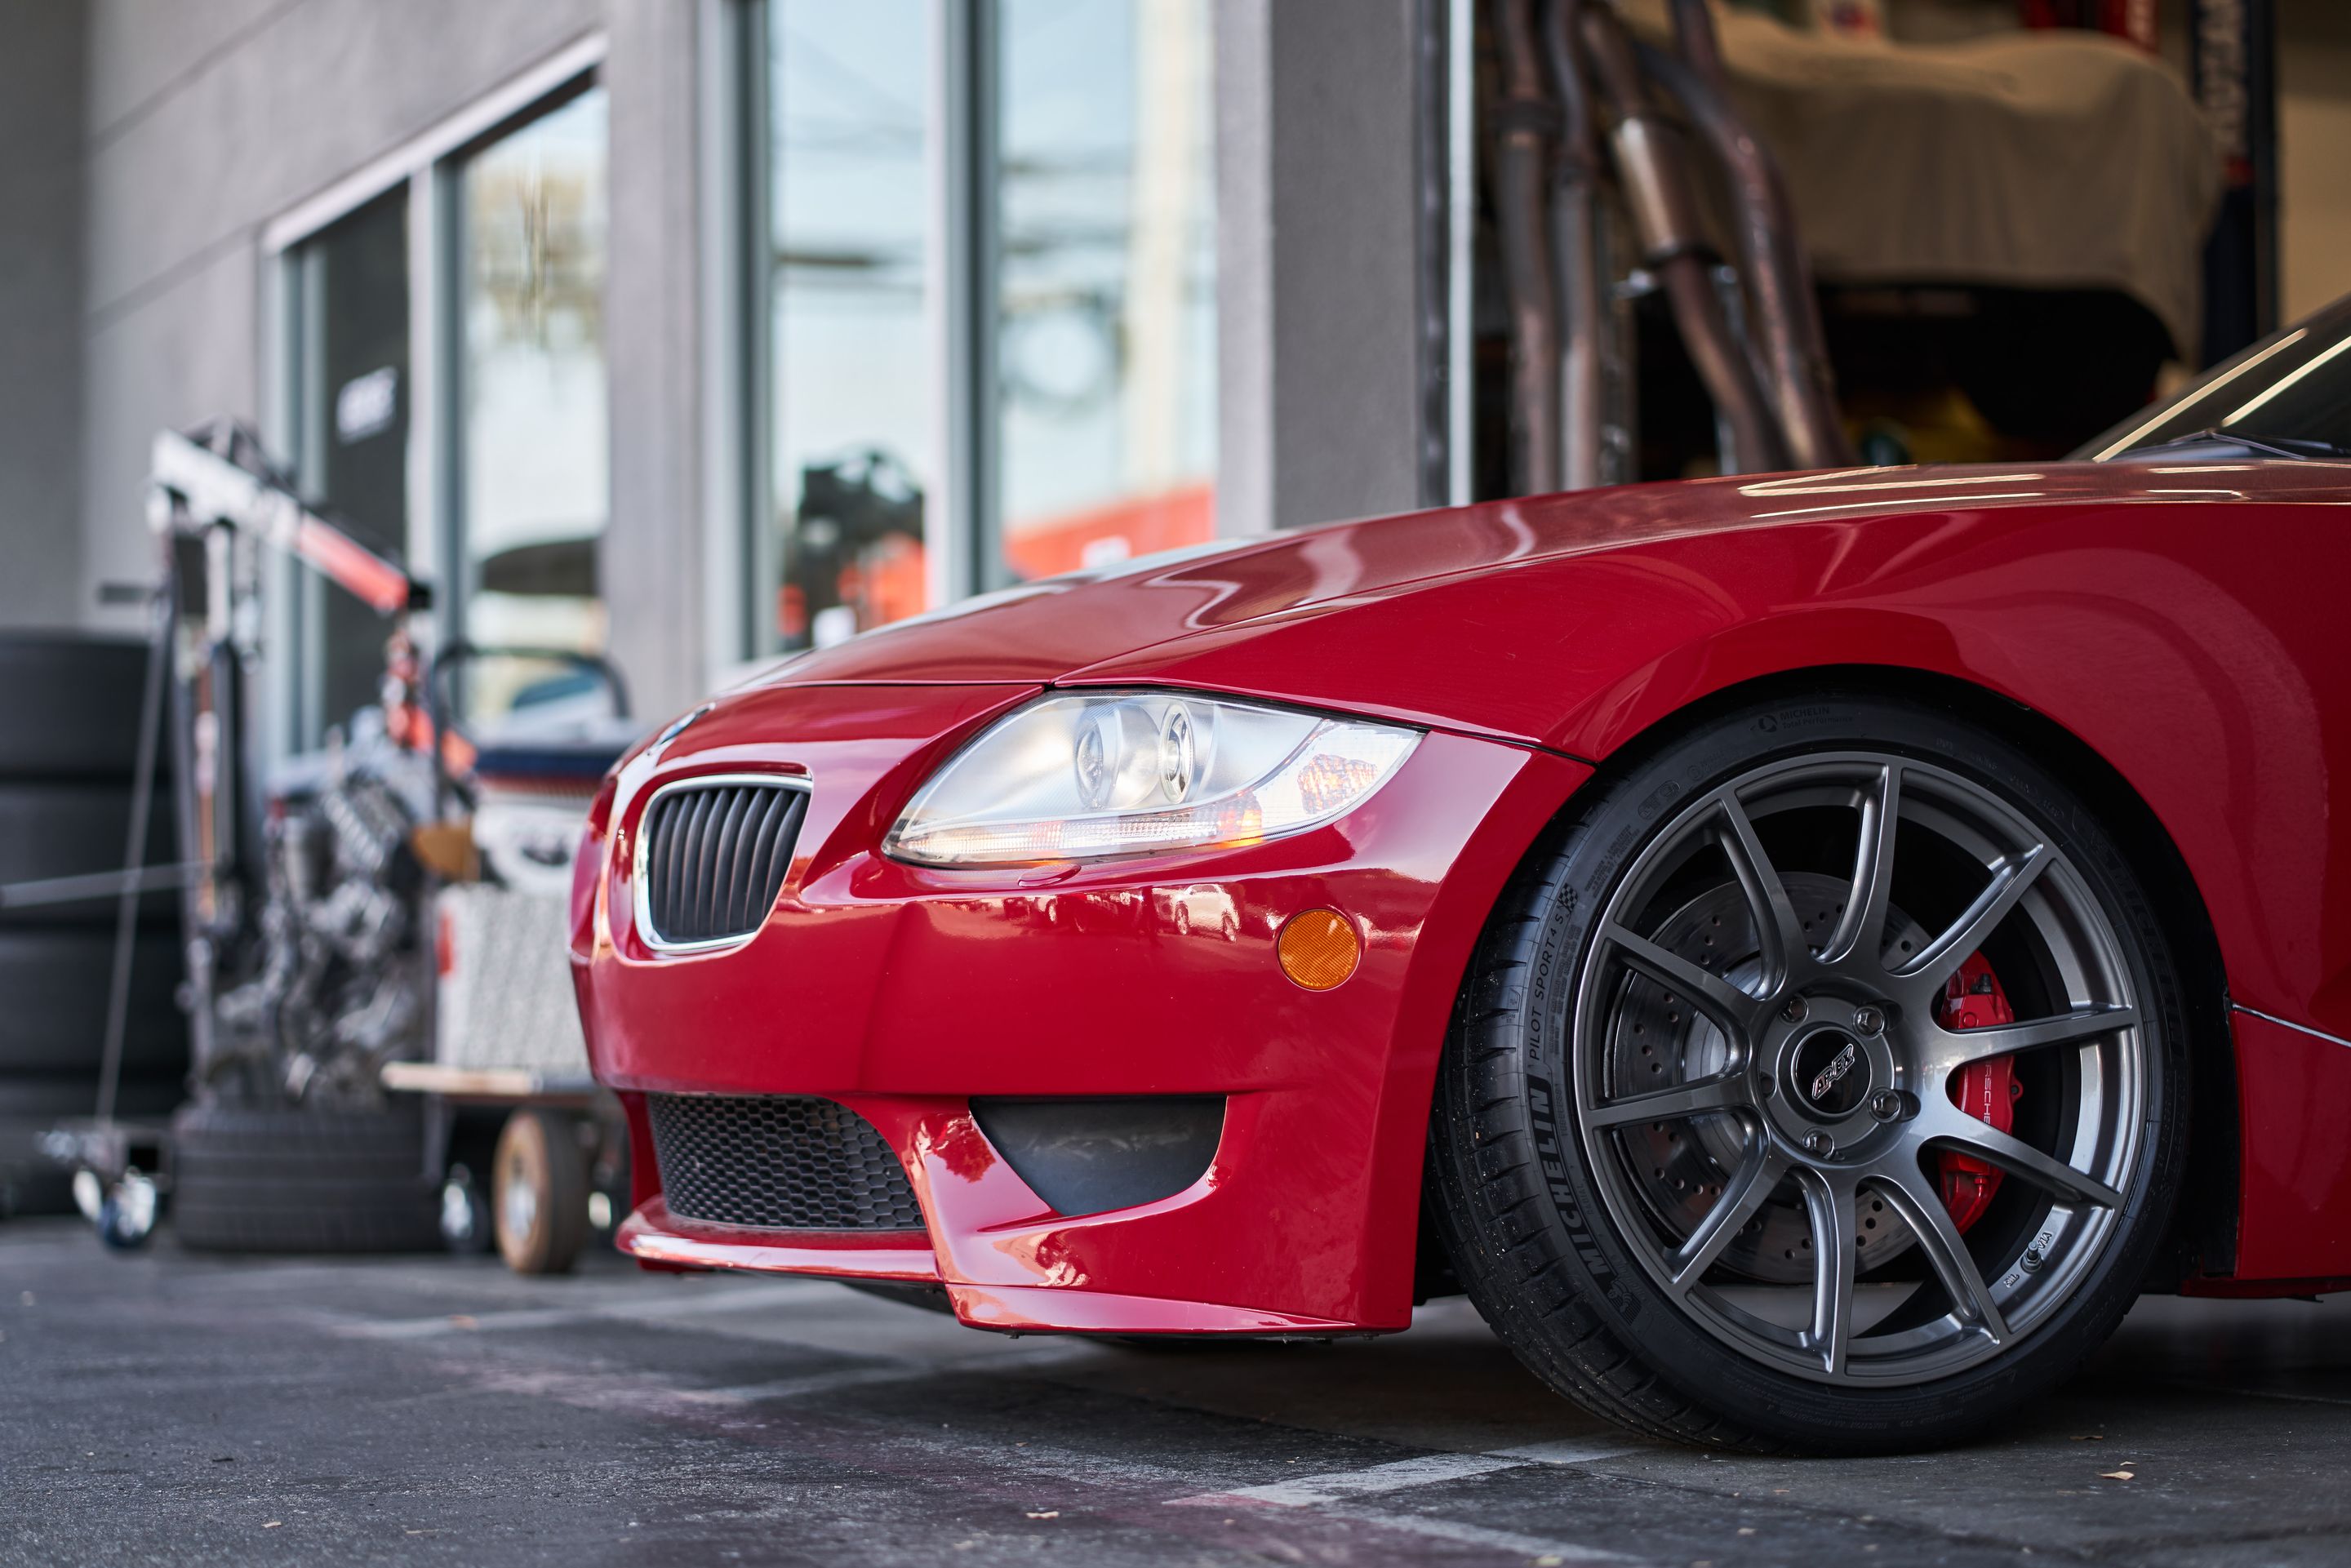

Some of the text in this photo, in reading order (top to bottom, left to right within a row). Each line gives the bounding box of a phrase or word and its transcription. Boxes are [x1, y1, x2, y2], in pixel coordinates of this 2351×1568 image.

[1780, 706, 1829, 720] MICHELIN
[1529, 1006, 1541, 1060] PILOT
[1554, 913, 1565, 926] S
[1812, 1043, 1855, 1099] APEX
[1984, 1063, 1992, 1125] RSCHE
[1529, 1086, 1611, 1275] MICHELIN
